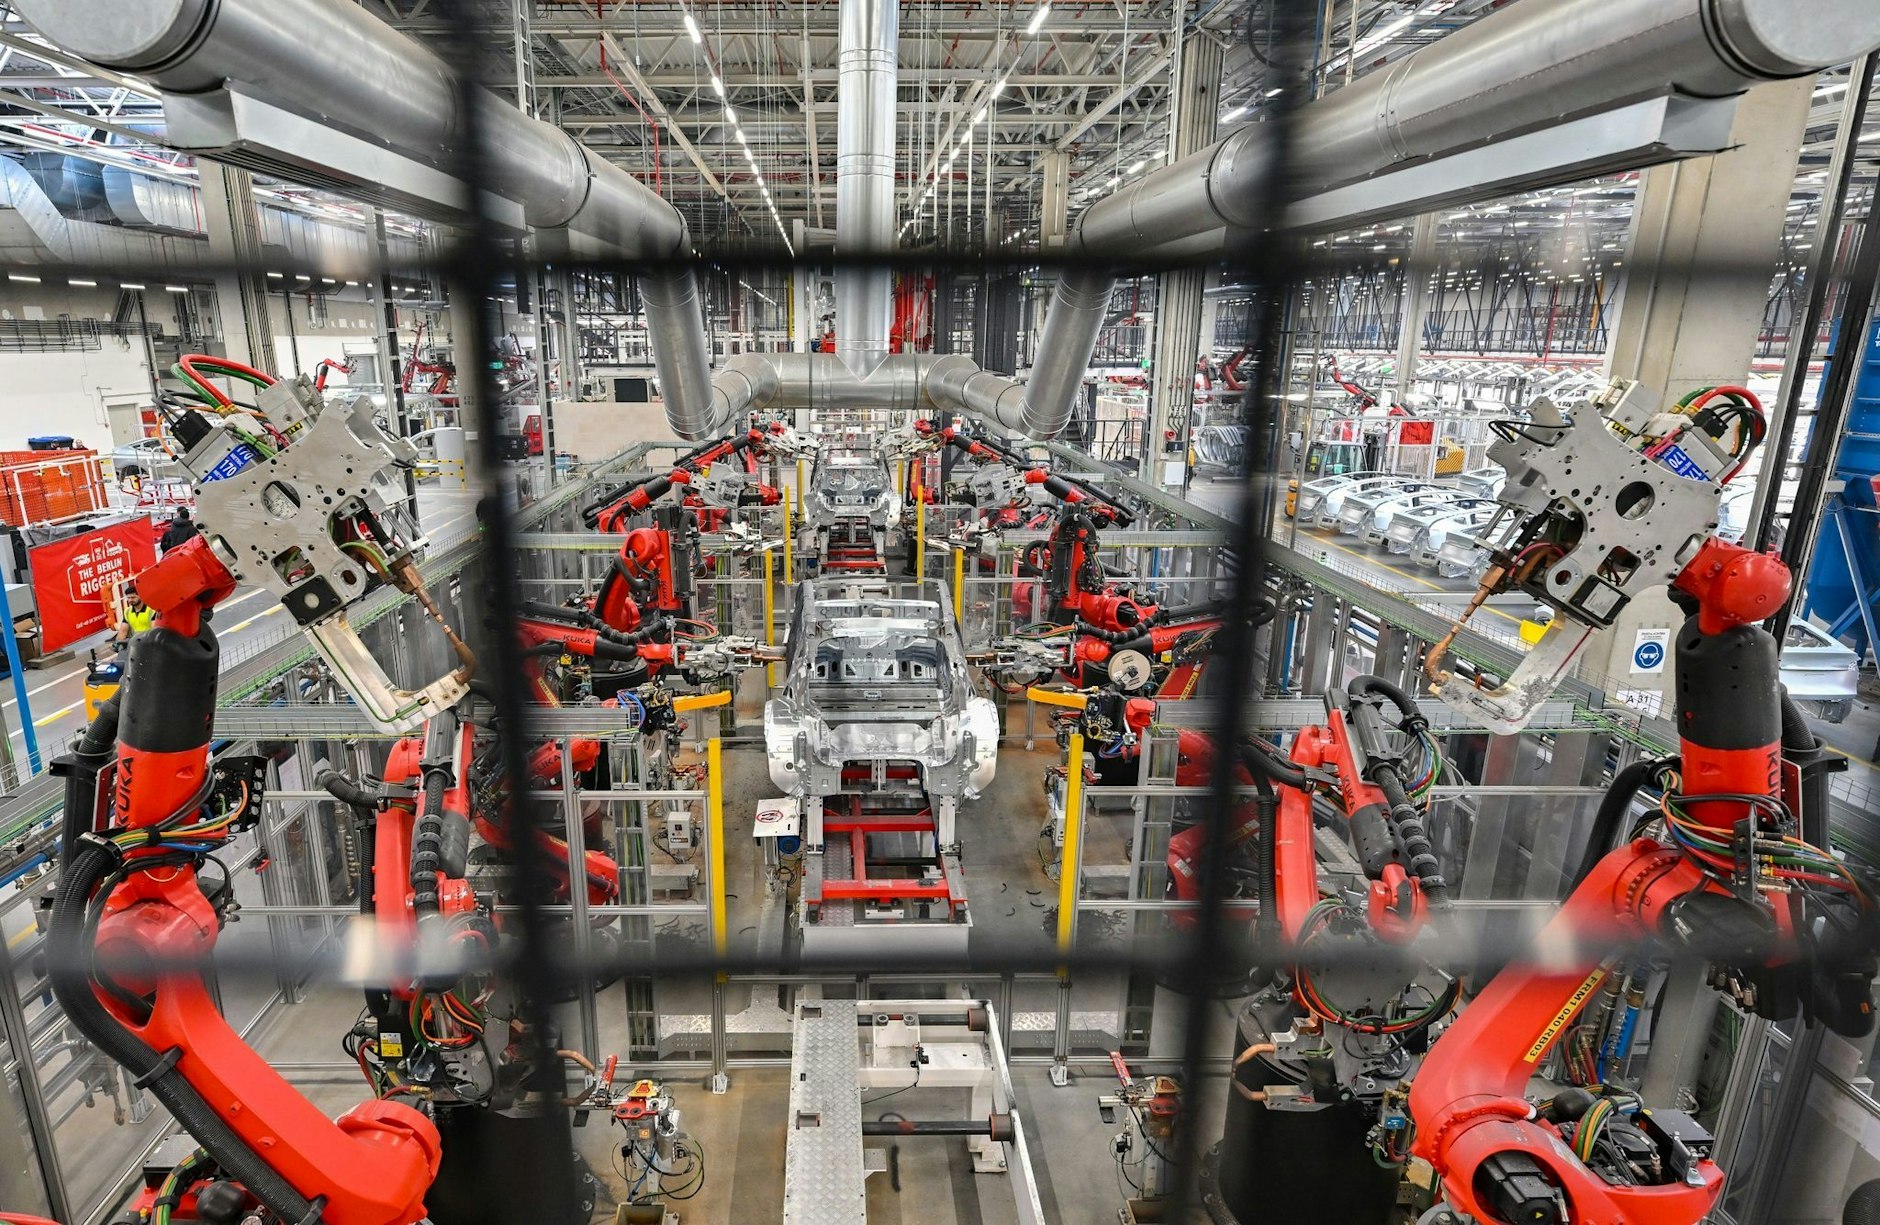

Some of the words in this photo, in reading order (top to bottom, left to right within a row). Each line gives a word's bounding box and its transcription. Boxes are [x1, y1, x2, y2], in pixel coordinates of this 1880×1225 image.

[220, 459, 237, 477] 170
[1669, 451, 1686, 468] 170
[78, 567, 94, 580] THE
[97, 557, 122, 574] BERLIN
[80, 569, 125, 597] RIGGERS
[563, 634, 592, 645] KUKA
[1155, 634, 1176, 644] KUK
[1626, 695, 1634, 704] A
[1637, 695, 1648, 704] 31
[536, 754, 561, 771] UKA
[116, 757, 133, 826] KUKA
[1342, 775, 1356, 810] KUKA
[1569, 976, 1598, 1006] FRM1
[1552, 1008, 1571, 1027] 040
[1529, 1028, 1555, 1057] RB03
